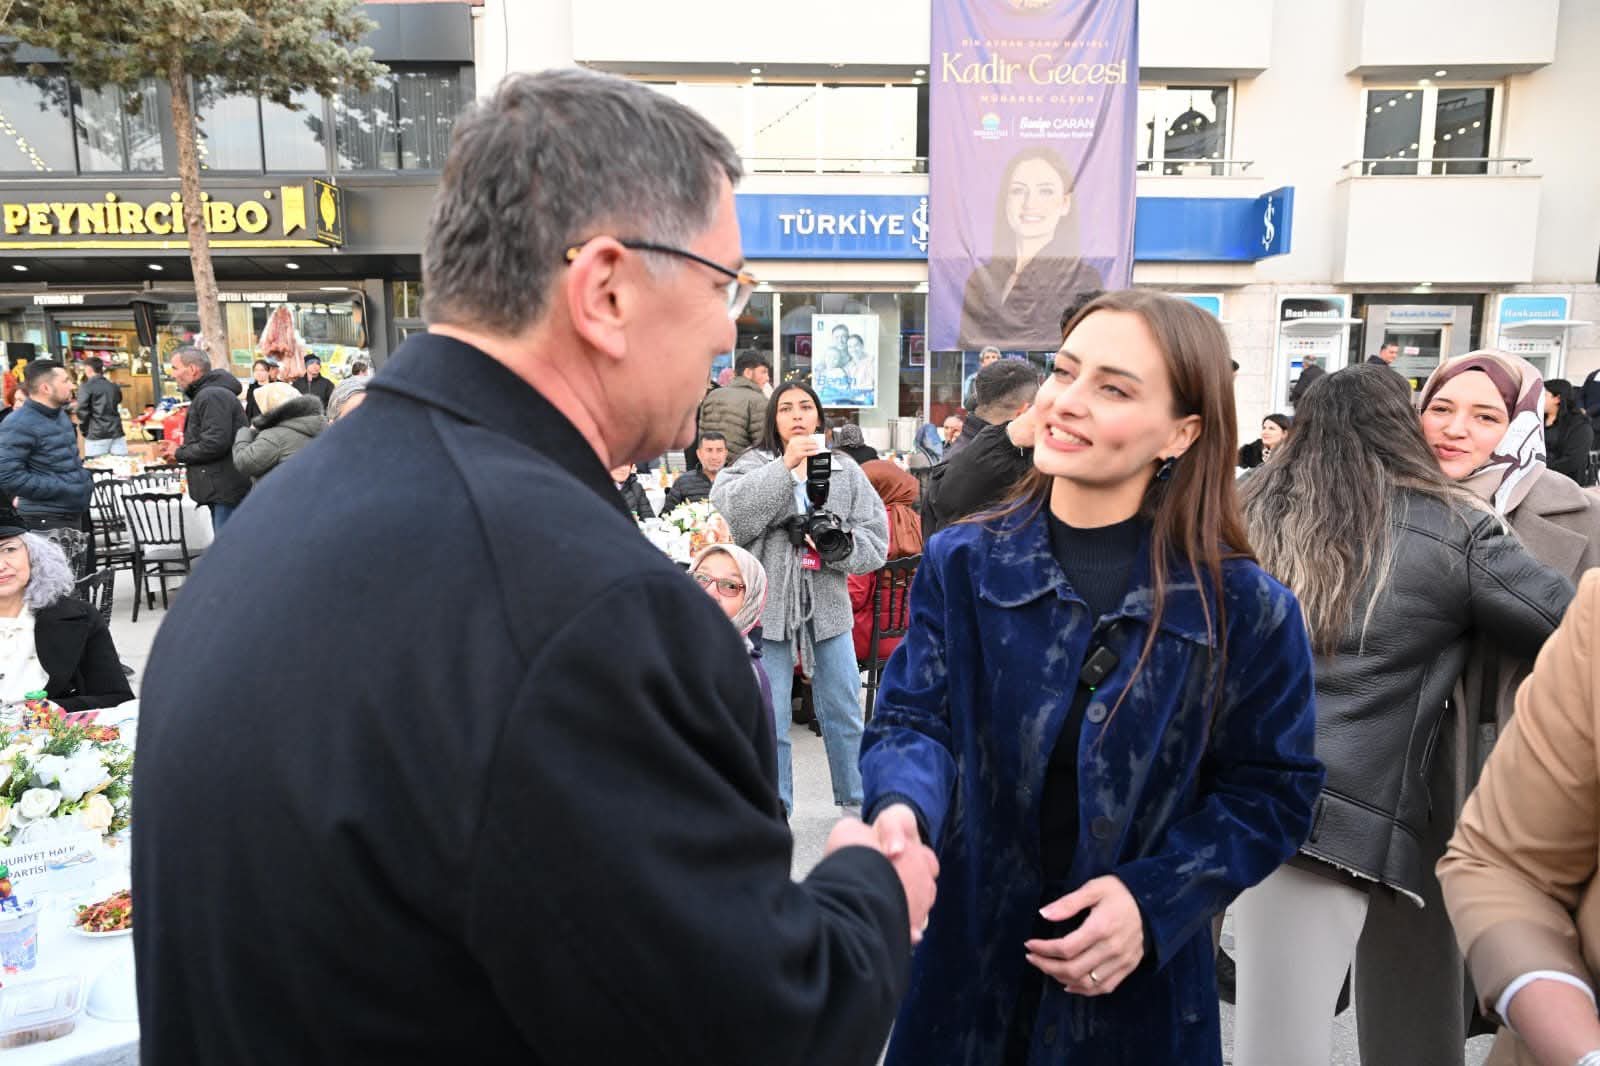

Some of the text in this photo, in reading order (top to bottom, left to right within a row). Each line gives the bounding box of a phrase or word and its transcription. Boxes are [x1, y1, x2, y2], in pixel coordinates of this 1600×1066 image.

[942, 51, 1128, 85] Kadir Gecesi
[3, 191, 186, 235] PEYNİRCİ
[778, 208, 905, 235] TÜRKİYE
